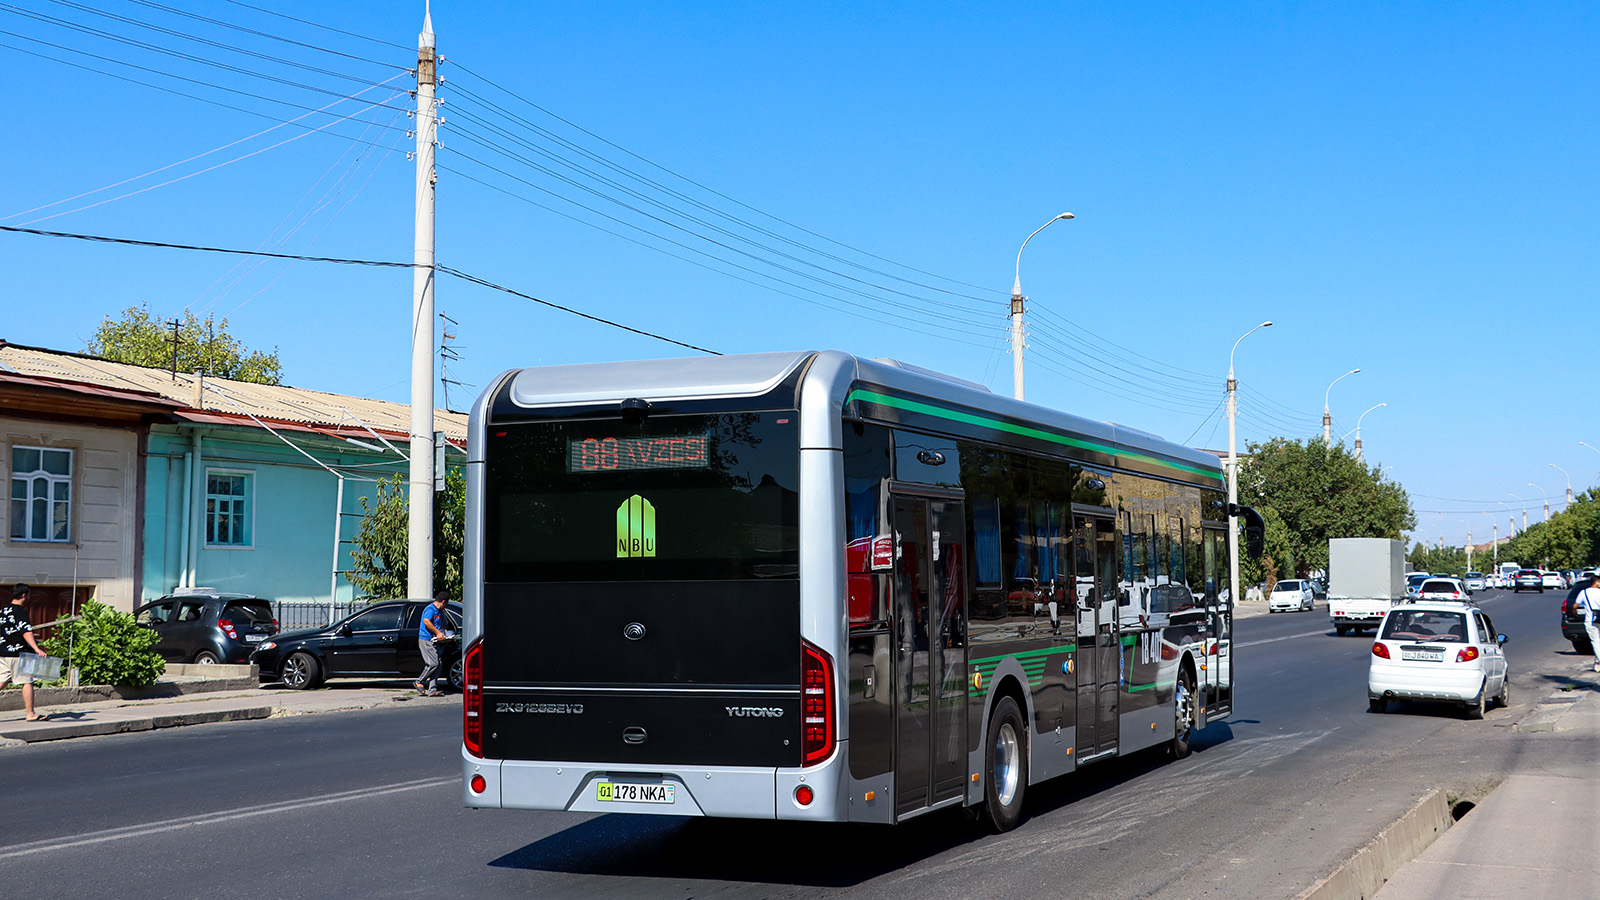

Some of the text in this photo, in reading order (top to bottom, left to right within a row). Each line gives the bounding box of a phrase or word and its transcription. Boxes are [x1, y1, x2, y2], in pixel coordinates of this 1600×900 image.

[619, 538, 654, 552] NBU
[1141, 632, 1149, 665] 18
[725, 706, 784, 718] YUTONG
[600, 785, 666, 801] 01 178 NKA
